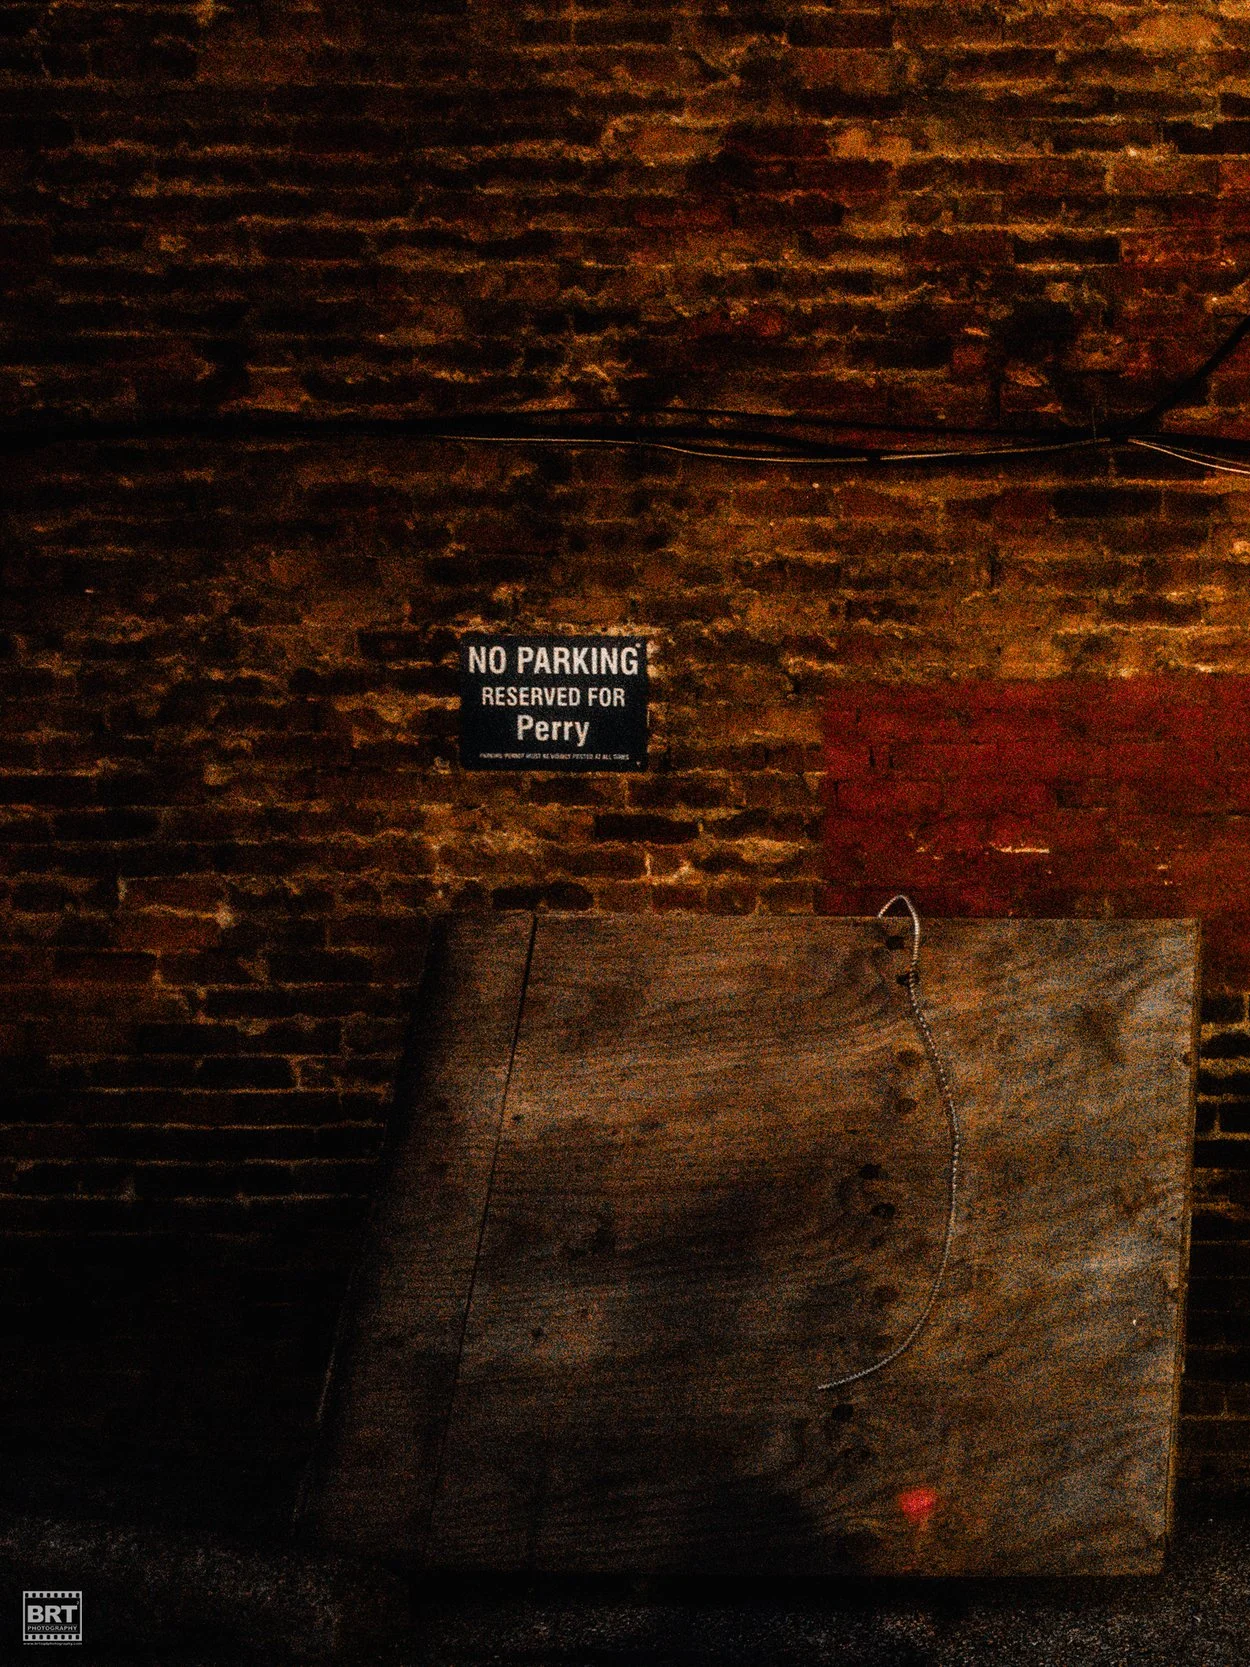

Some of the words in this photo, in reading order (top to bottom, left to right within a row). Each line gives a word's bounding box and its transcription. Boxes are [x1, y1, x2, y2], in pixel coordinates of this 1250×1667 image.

[468, 646, 507, 674] NO
[517, 646, 639, 675] PARKING
[482, 686, 581, 707] RESERVED
[588, 687, 626, 707] FOR
[517, 714, 590, 747] Perry
